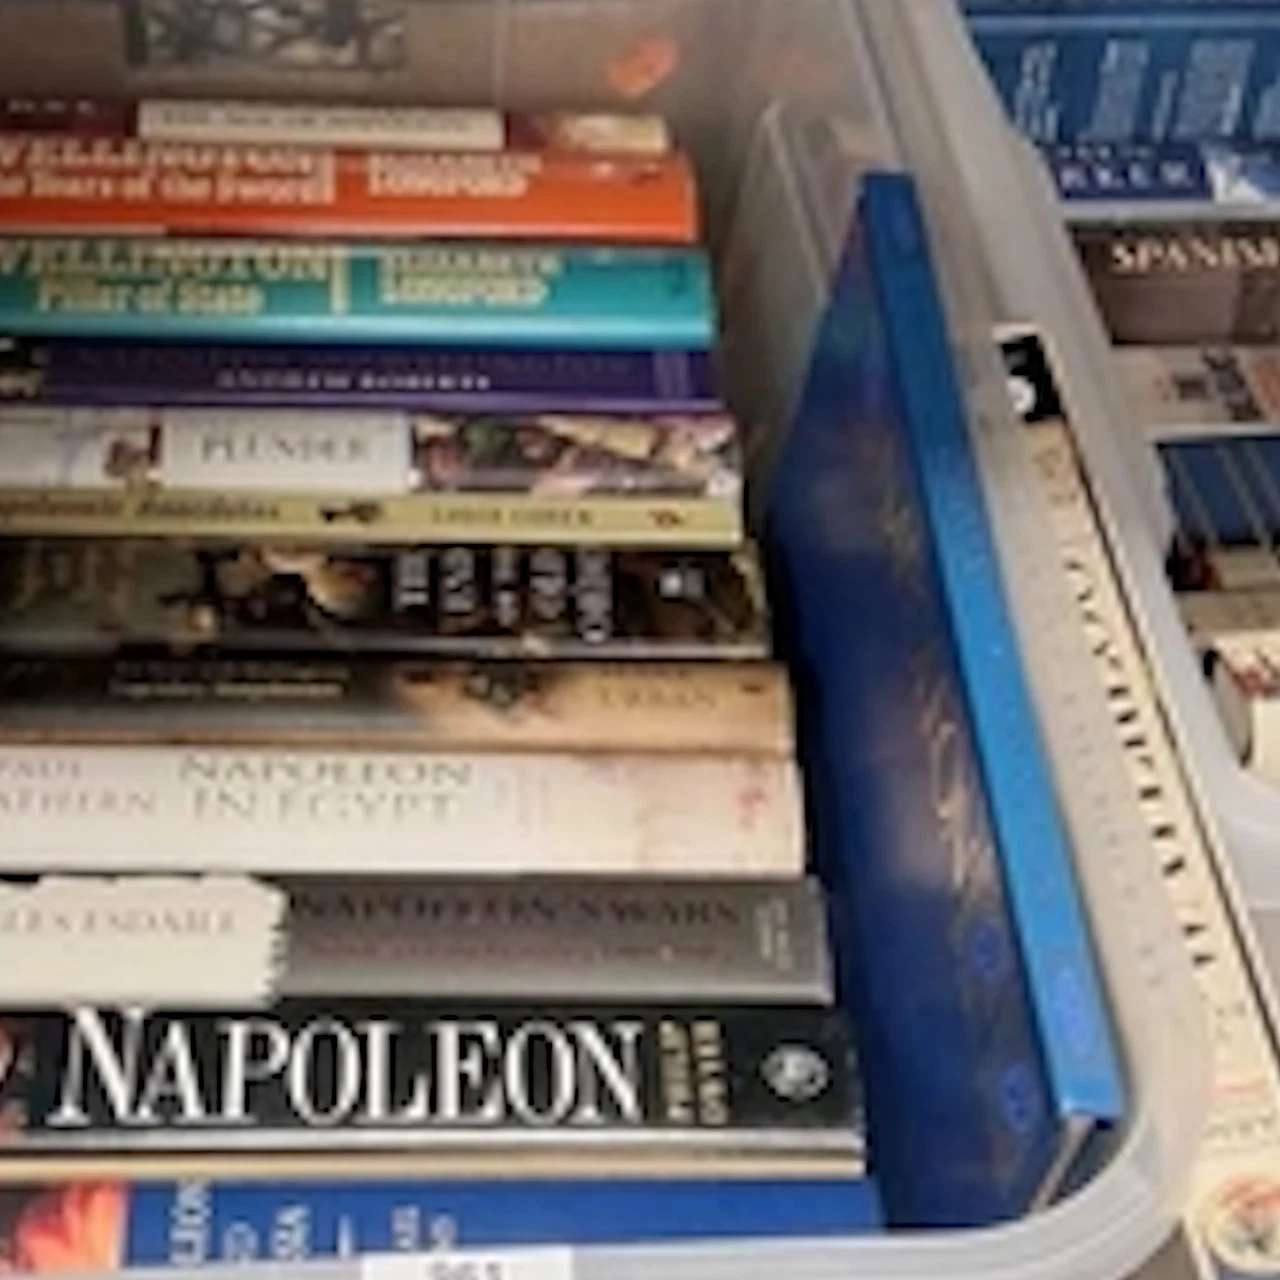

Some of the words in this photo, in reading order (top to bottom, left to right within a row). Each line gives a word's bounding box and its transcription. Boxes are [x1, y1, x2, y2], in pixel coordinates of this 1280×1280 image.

[199, 434, 373, 465] PLUNDER
[177, 753, 474, 788] NAPOLEON
[191, 793, 258, 820] IN
[276, 793, 461, 824] EGYPT
[46, 1006, 648, 1128] NAPOLEON
